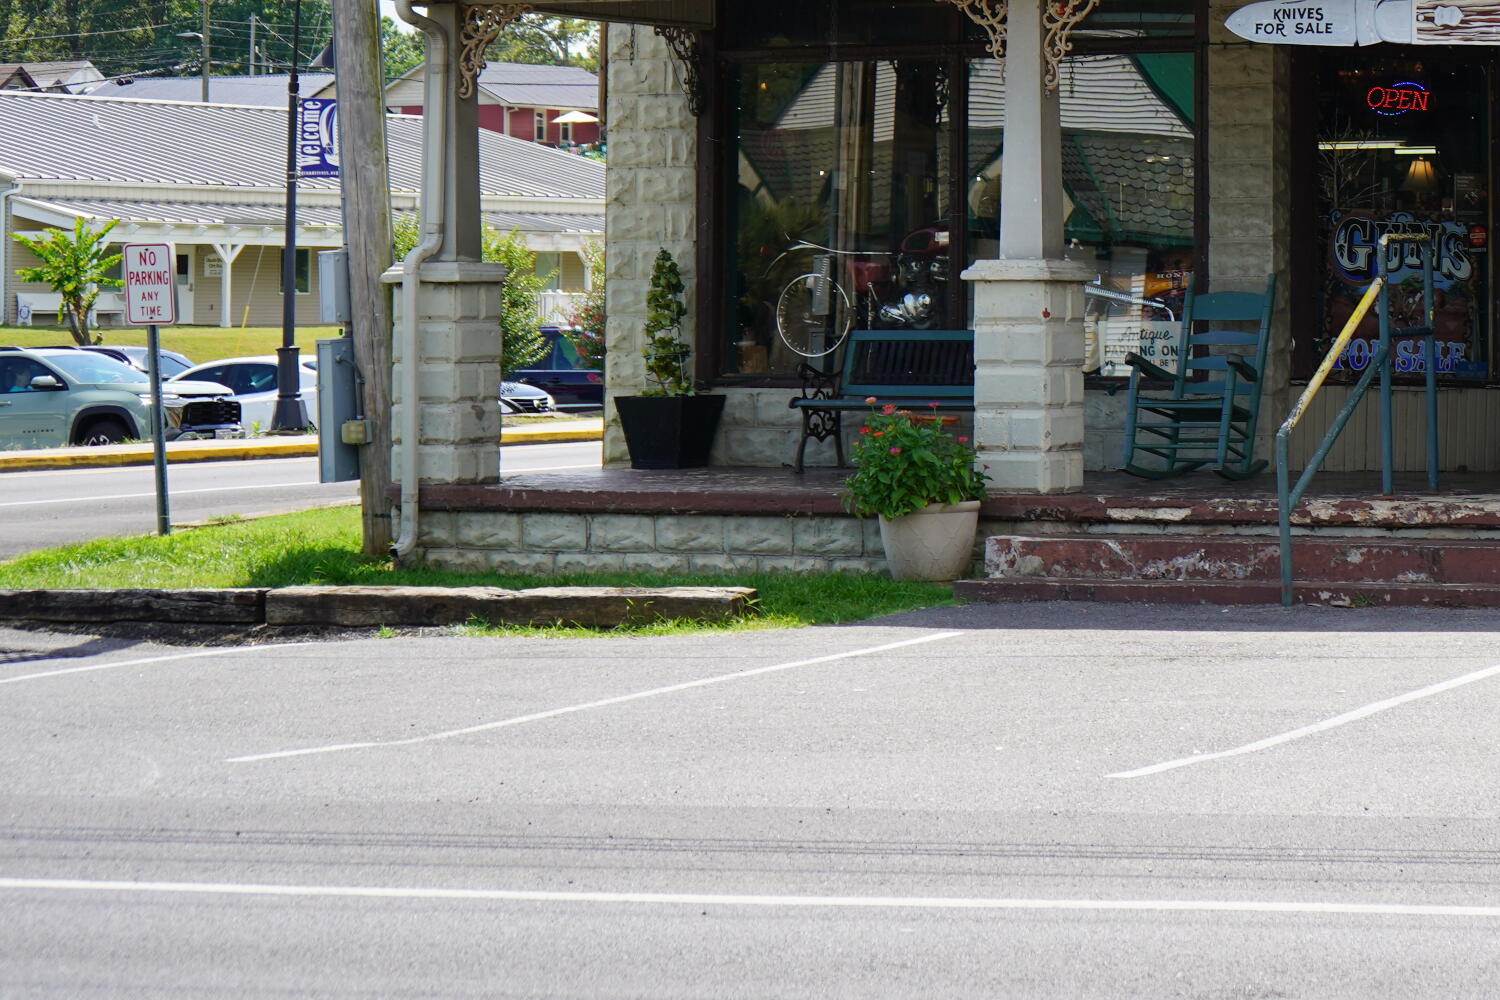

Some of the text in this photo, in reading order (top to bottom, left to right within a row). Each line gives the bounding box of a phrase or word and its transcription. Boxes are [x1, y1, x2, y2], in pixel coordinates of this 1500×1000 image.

[1273, 7, 1324, 23] KNIVES
[1255, 22, 1333, 37] FOR SALE
[1366, 85, 1431, 112] OPEN
[138, 250, 157, 267] NO
[128, 271, 170, 287] PARKING
[140, 290, 160, 302] ANY
[139, 305, 162, 317] TIME
